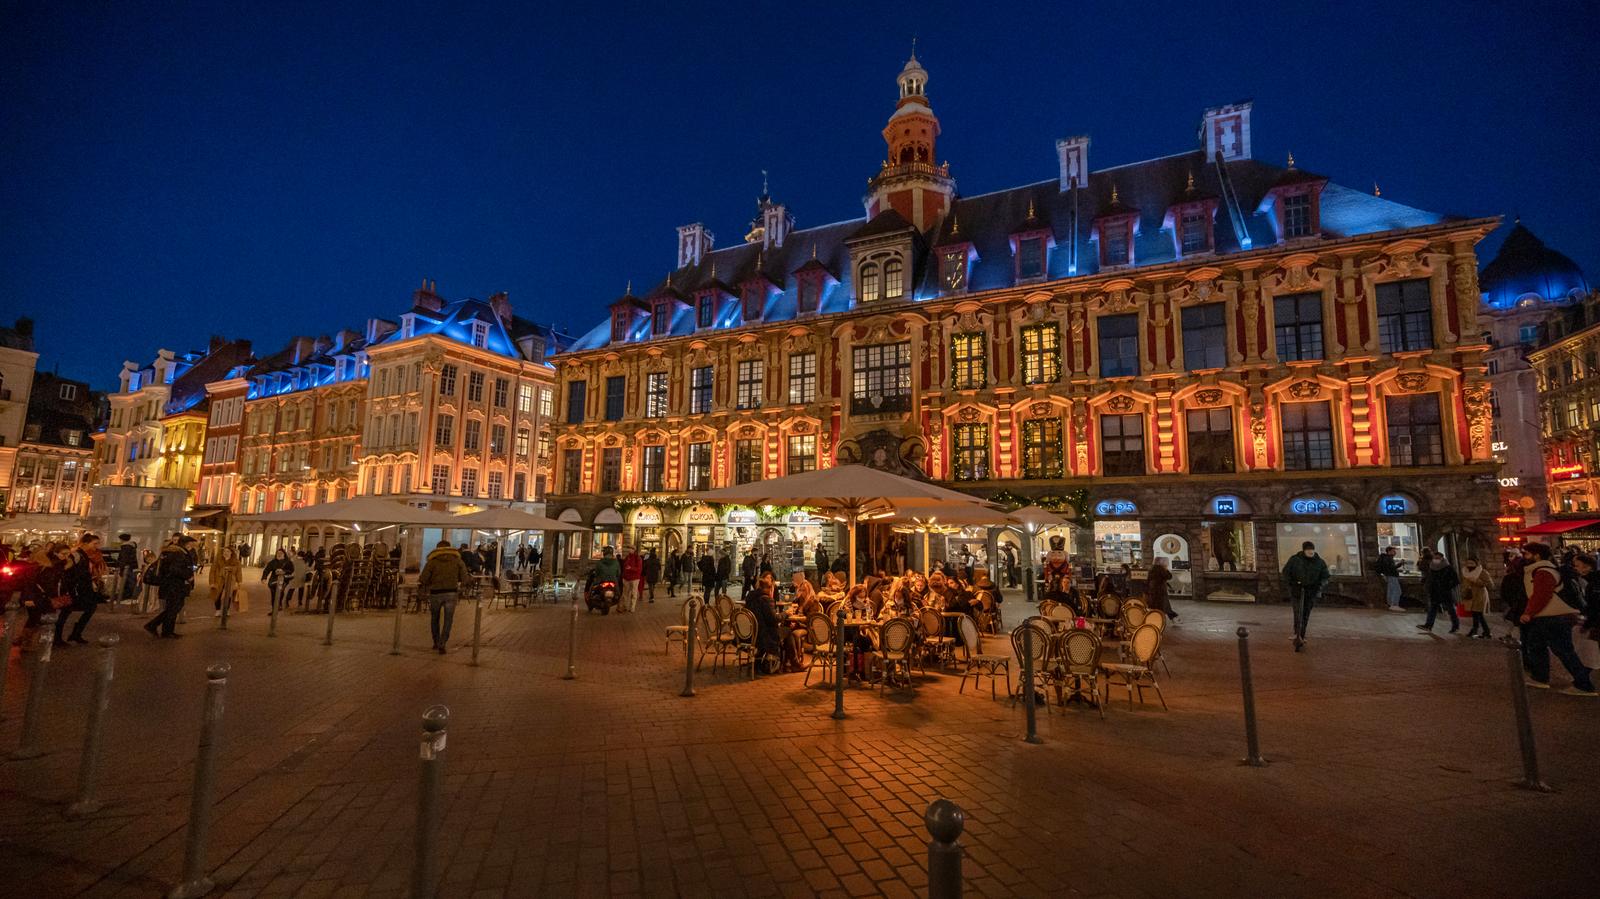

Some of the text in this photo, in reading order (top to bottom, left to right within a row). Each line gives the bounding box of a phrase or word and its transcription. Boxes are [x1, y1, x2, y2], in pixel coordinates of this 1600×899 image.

[1491, 441, 1508, 451] EL
[1497, 477, 1519, 487] ON
[689, 513, 715, 521] KOKOA
